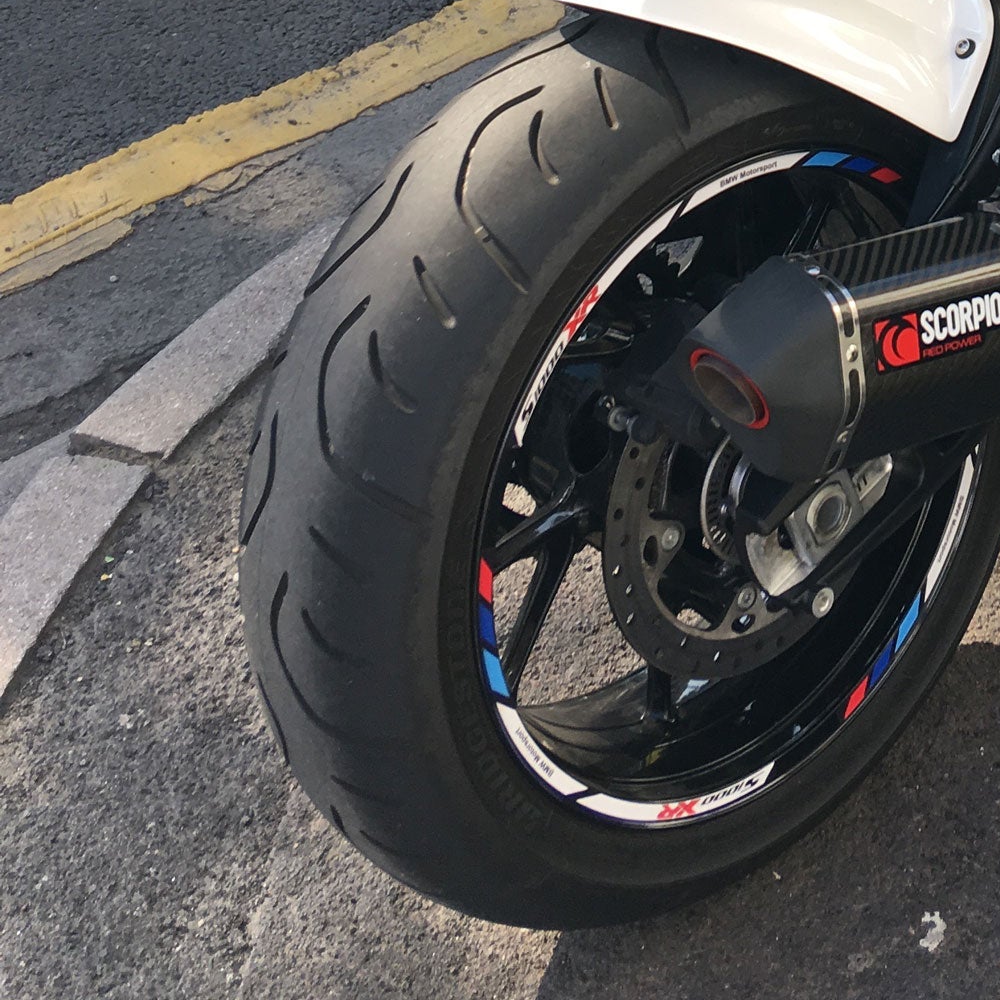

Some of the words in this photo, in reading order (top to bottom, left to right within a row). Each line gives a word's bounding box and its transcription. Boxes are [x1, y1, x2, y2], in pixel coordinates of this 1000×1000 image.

[719, 174, 740, 188] BMW
[740, 161, 778, 179] Motorsport
[562, 284, 602, 342] XR
[922, 344, 944, 358] RED
[945, 333, 982, 353] POWER
[656, 797, 701, 821] XR
